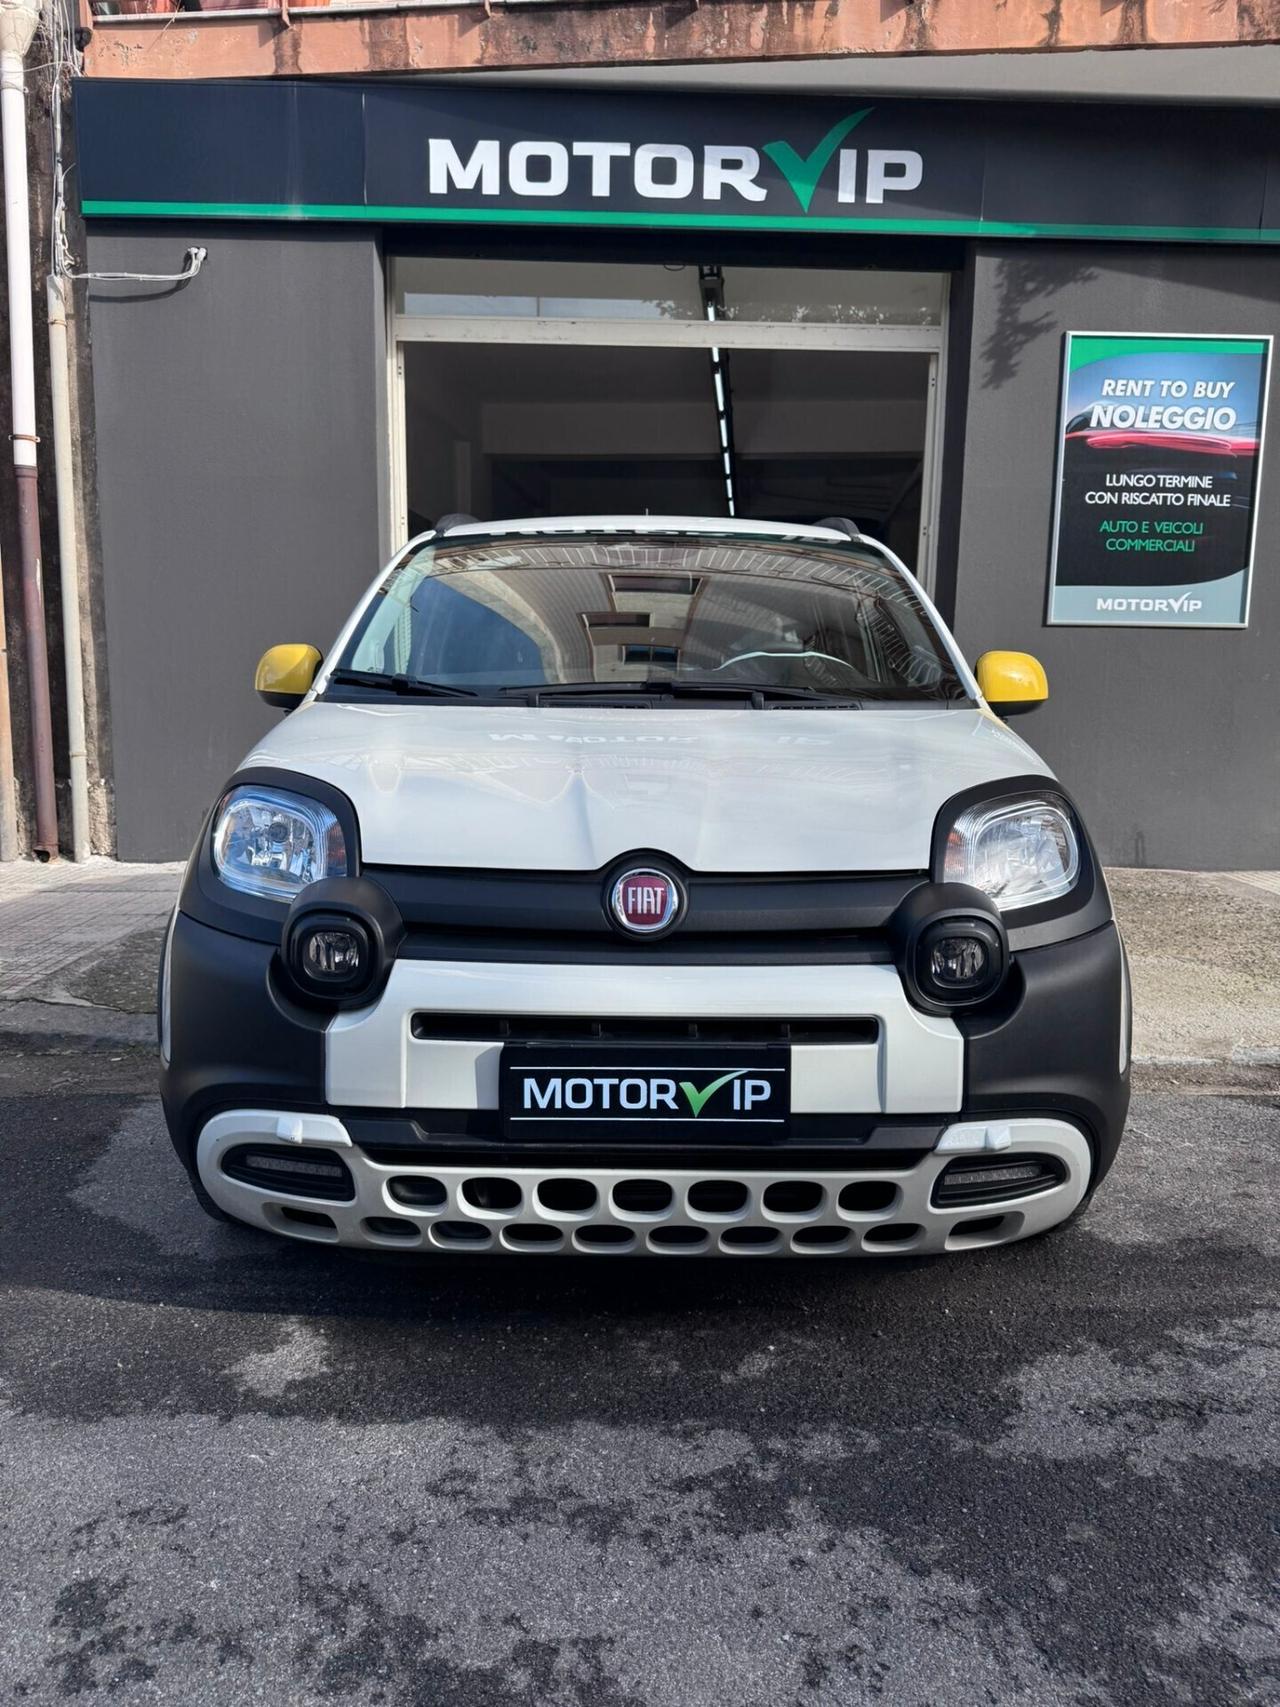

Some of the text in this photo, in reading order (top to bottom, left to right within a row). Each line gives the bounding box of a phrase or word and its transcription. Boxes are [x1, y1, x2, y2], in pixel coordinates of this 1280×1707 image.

[428, 107, 924, 213] MOTORVIP
[1101, 379, 1235, 399] RENT TO BUY
[1090, 404, 1237, 431] NOLEGGIO
[1105, 474, 1213, 489] LUNGO TERMINE
[1085, 491, 1231, 507] CON RISCATTO FINALE
[1099, 520, 1204, 535] AUTO E VEICOLI
[1105, 538, 1196, 553] COMMERCIALI
[1096, 591, 1203, 613] MOTORVIP
[627, 886, 665, 915] FIAT
[522, 1069, 772, 1118] MOTORVIP
